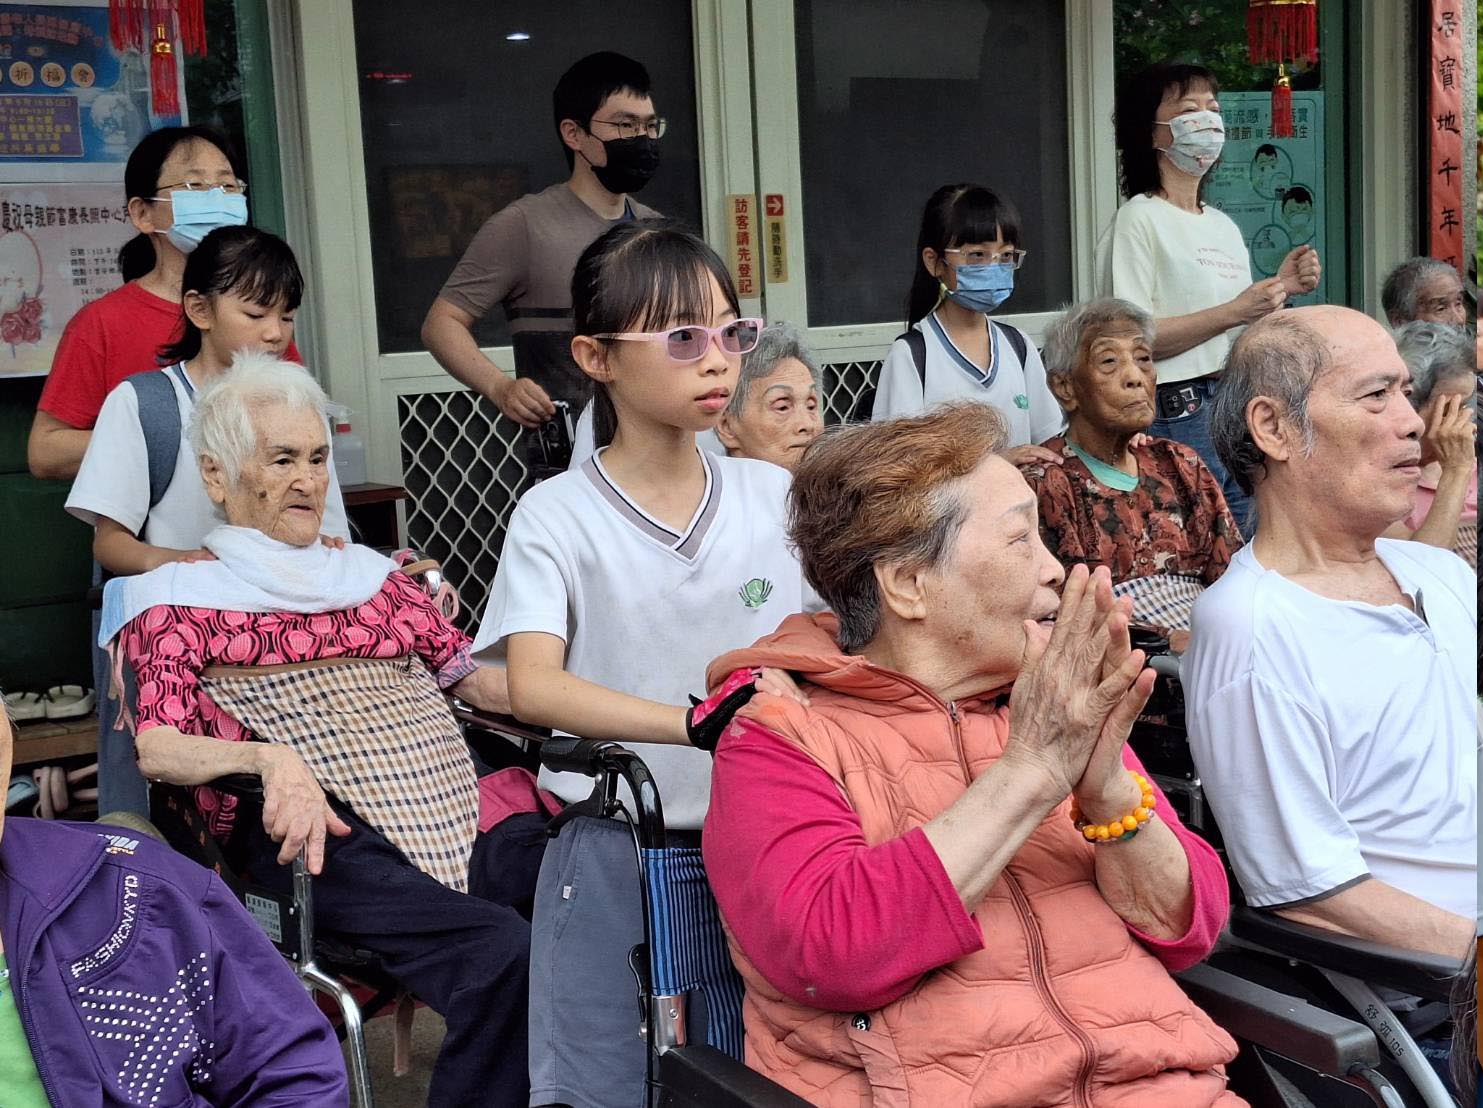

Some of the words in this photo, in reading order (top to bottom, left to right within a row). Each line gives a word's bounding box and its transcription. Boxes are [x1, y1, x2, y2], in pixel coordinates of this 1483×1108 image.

[735, 198, 752, 294] 訪客請先登記
